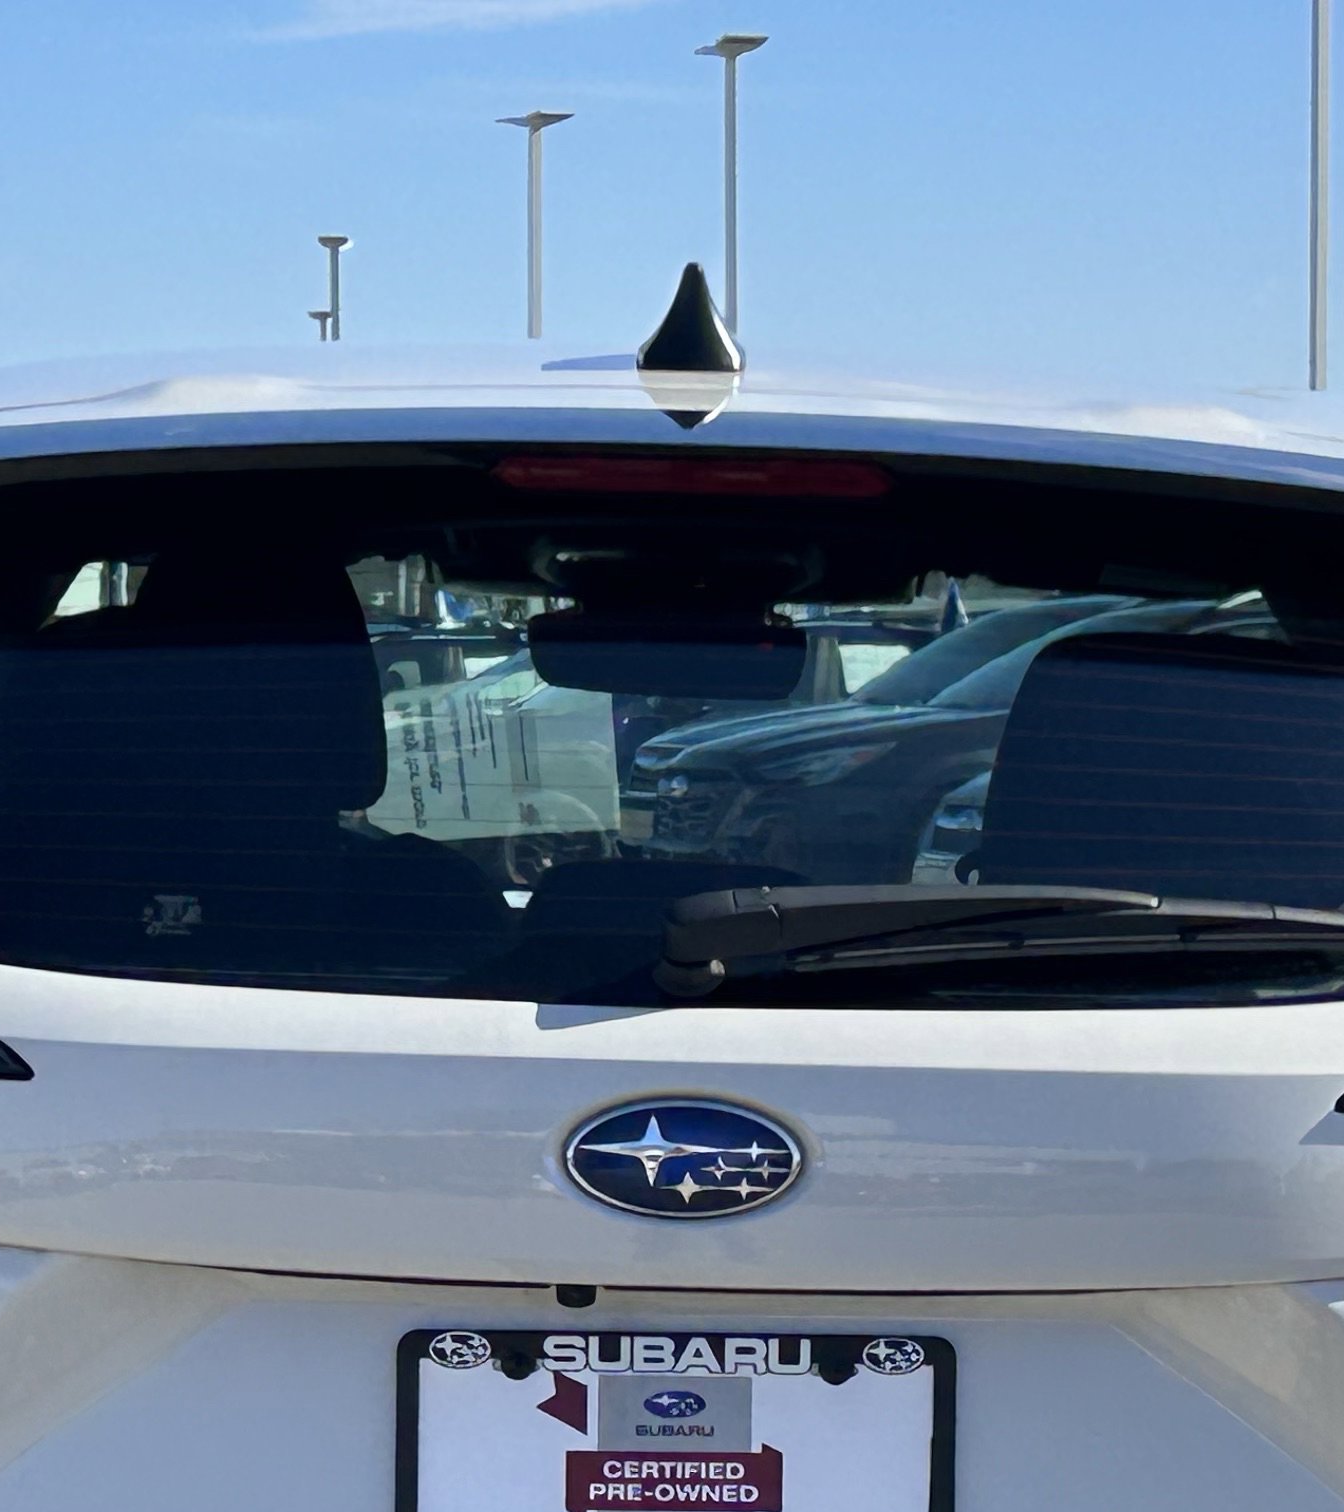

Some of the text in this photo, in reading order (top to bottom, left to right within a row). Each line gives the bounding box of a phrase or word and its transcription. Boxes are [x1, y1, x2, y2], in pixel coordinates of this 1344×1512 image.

[543, 1335, 813, 1375] SUBARU
[635, 1424, 715, 1437] SUBARU
[602, 1460, 746, 1481] CERTIFIED
[588, 1482, 760, 1503] PRE-OWNED
